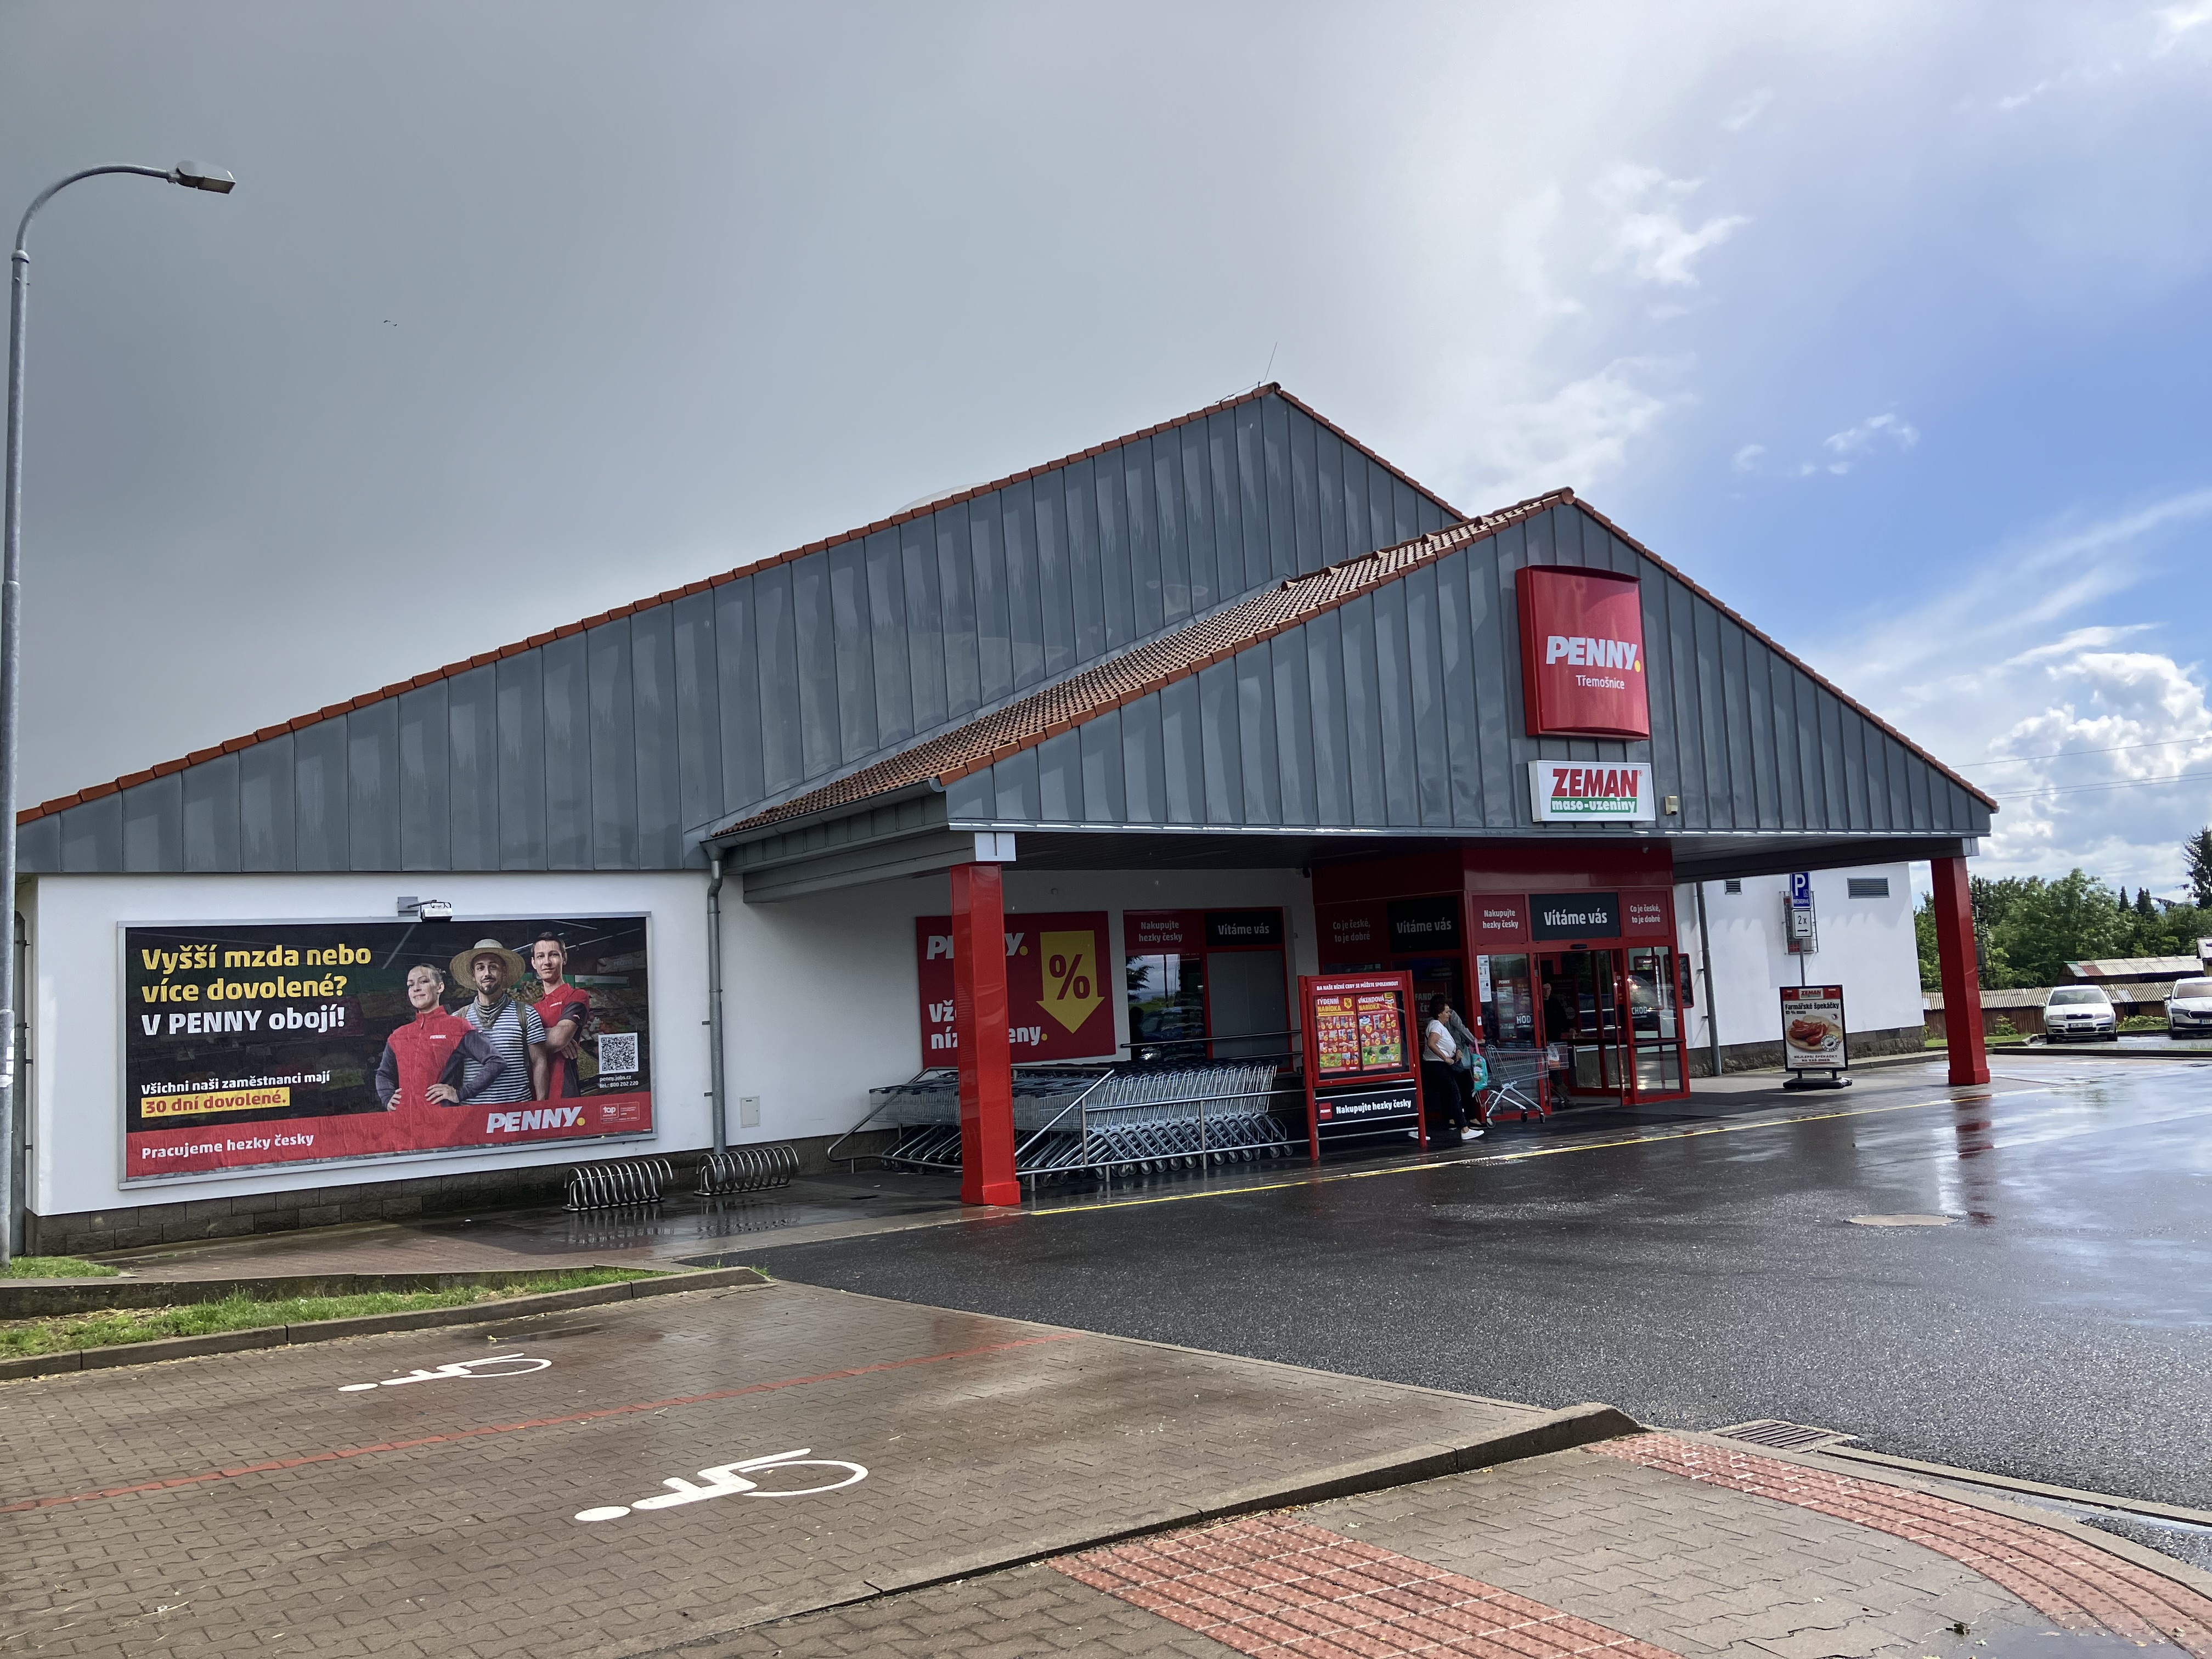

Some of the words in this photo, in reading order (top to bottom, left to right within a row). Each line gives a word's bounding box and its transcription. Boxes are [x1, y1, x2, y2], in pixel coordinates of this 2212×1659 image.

[1576, 674, 1626, 690] Třemošnice
[1551, 769, 1638, 797] ZEMAN
[1551, 798, 1636, 813] maso-uzeniny
[1795, 874, 1806, 896] P
[1483, 908, 1516, 918] Nakupujte
[1638, 905, 1644, 913] je
[1644, 904, 1661, 913] české,
[1544, 909, 1586, 926] Vítáme
[1588, 907, 1608, 924] vás
[1638, 916, 1644, 924] je
[1798, 916, 1802, 924] 2
[1141, 920, 1180, 931] Nakupujte
[1217, 923, 1252, 935] Vítáme
[1254, 922, 1269, 934] vás
[1333, 921, 1341, 930] Co
[1342, 919, 1348, 931] je
[1397, 919, 1432, 933] Vítáme
[1434, 917, 1452, 931] vás
[1482, 921, 1501, 930] hezky
[1502, 919, 1519, 929] česky
[1138, 933, 1161, 943] hezky
[1162, 932, 1183, 943] česky
[1335, 934, 1342, 943] to
[1342, 933, 1349, 944] je
[1351, 930, 1370, 941] dobré
[142, 944, 218, 974] Vyšší
[224, 945, 299, 968] mzda
[307, 944, 371, 966] nebo
[142, 978, 199, 1003] více
[207, 973, 347, 1001] dovolené?
[1317, 996, 1339, 1005] TÝDENNÍ
[1358, 995, 1385, 1003] VÍKENDOVÁ
[1318, 1004, 1341, 1012] NABÍDKA
[1358, 1002, 1380, 1011] NABÍDKA
[141, 1014, 161, 1036] V
[169, 1010, 262, 1035] PENNY
[269, 1004, 346, 1033] obojí!
[141, 1080, 189, 1095] Všichni
[192, 1078, 219, 1092] naši
[222, 1072, 301, 1089] zaměstnanci
[304, 1070, 331, 1085] mají
[599, 1075, 632, 1083] penny.jobs.cz
[145, 1100, 167, 1114] 30
[171, 1093, 199, 1111] dní
[204, 1090, 287, 1109] dovolené.
[1336, 1102, 1372, 1114] Nakupujte
[1372, 1101, 1392, 1110] hezky
[1393, 1099, 1412, 1108] česky
[142, 1142, 223, 1159] Pracujeme
[227, 1136, 271, 1151] hezky
[274, 1133, 314, 1147] česky
